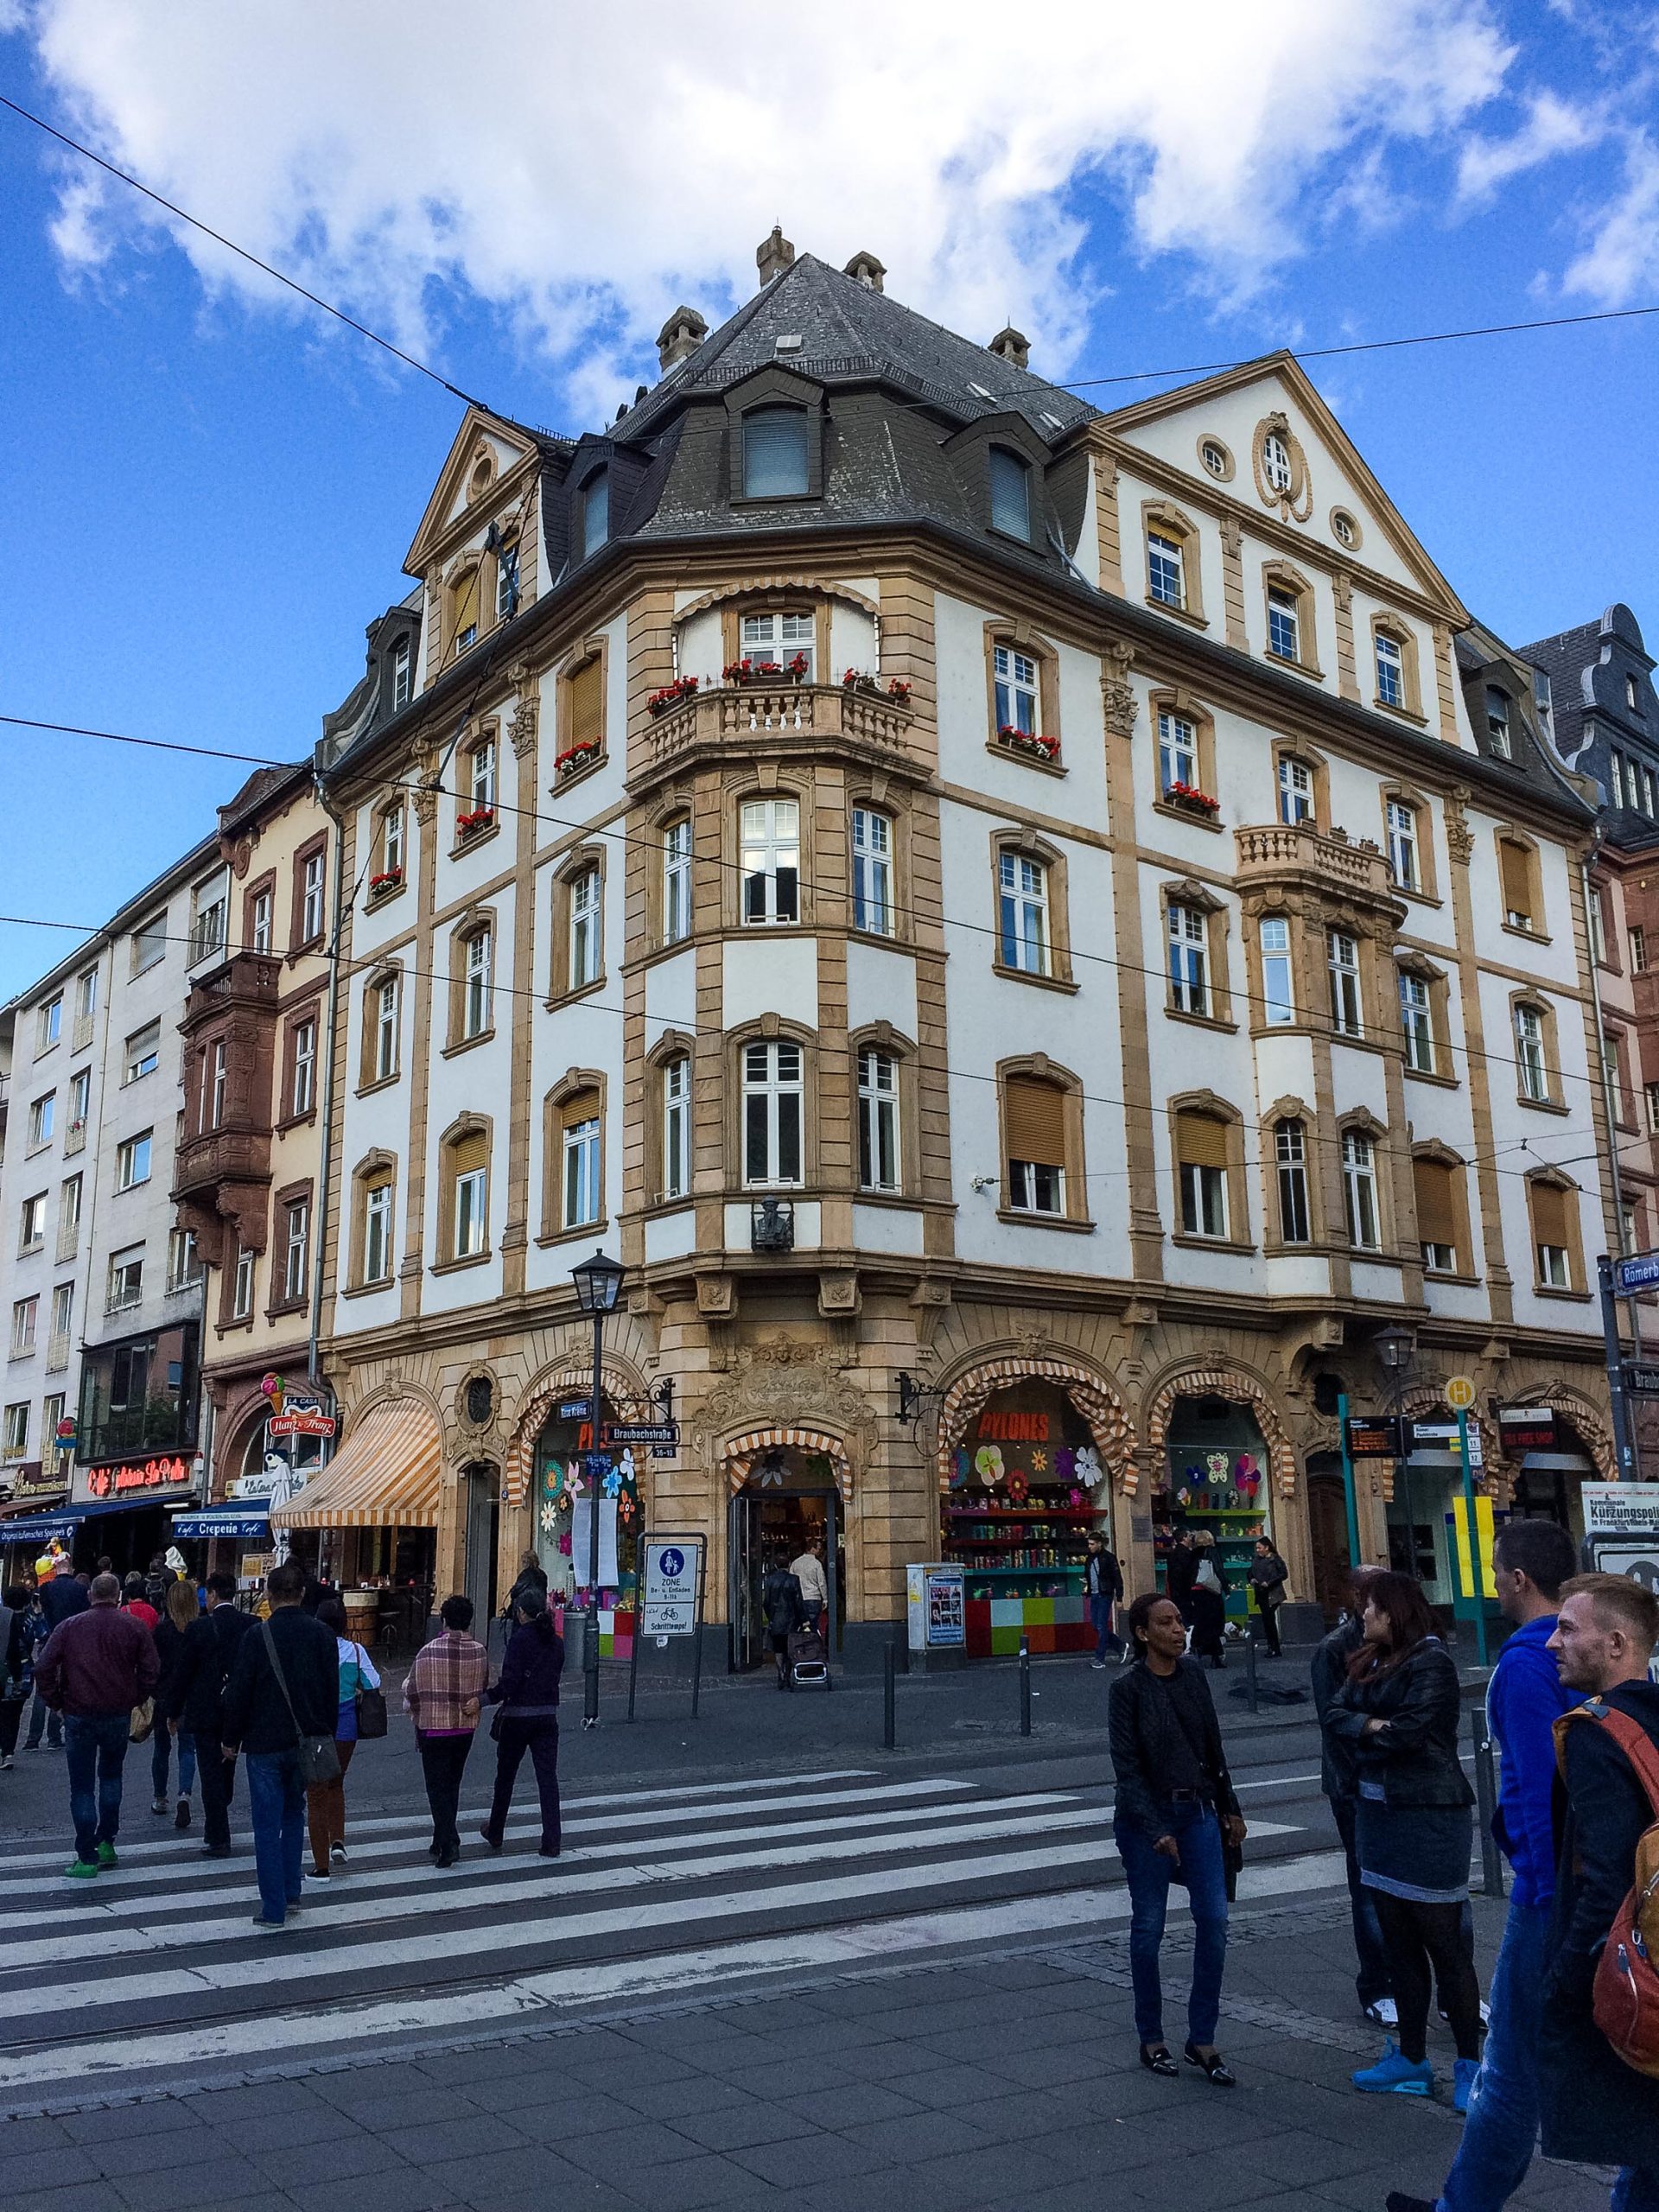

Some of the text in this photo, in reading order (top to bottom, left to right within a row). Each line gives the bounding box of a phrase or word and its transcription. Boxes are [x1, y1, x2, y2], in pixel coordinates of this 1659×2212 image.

[1624, 1262, 1659, 1283] Römerb
[613, 1428, 671, 1441] Braubachstraße
[978, 1412, 1049, 1441] PYLONES
[662, 1578, 681, 1586] ZONE
